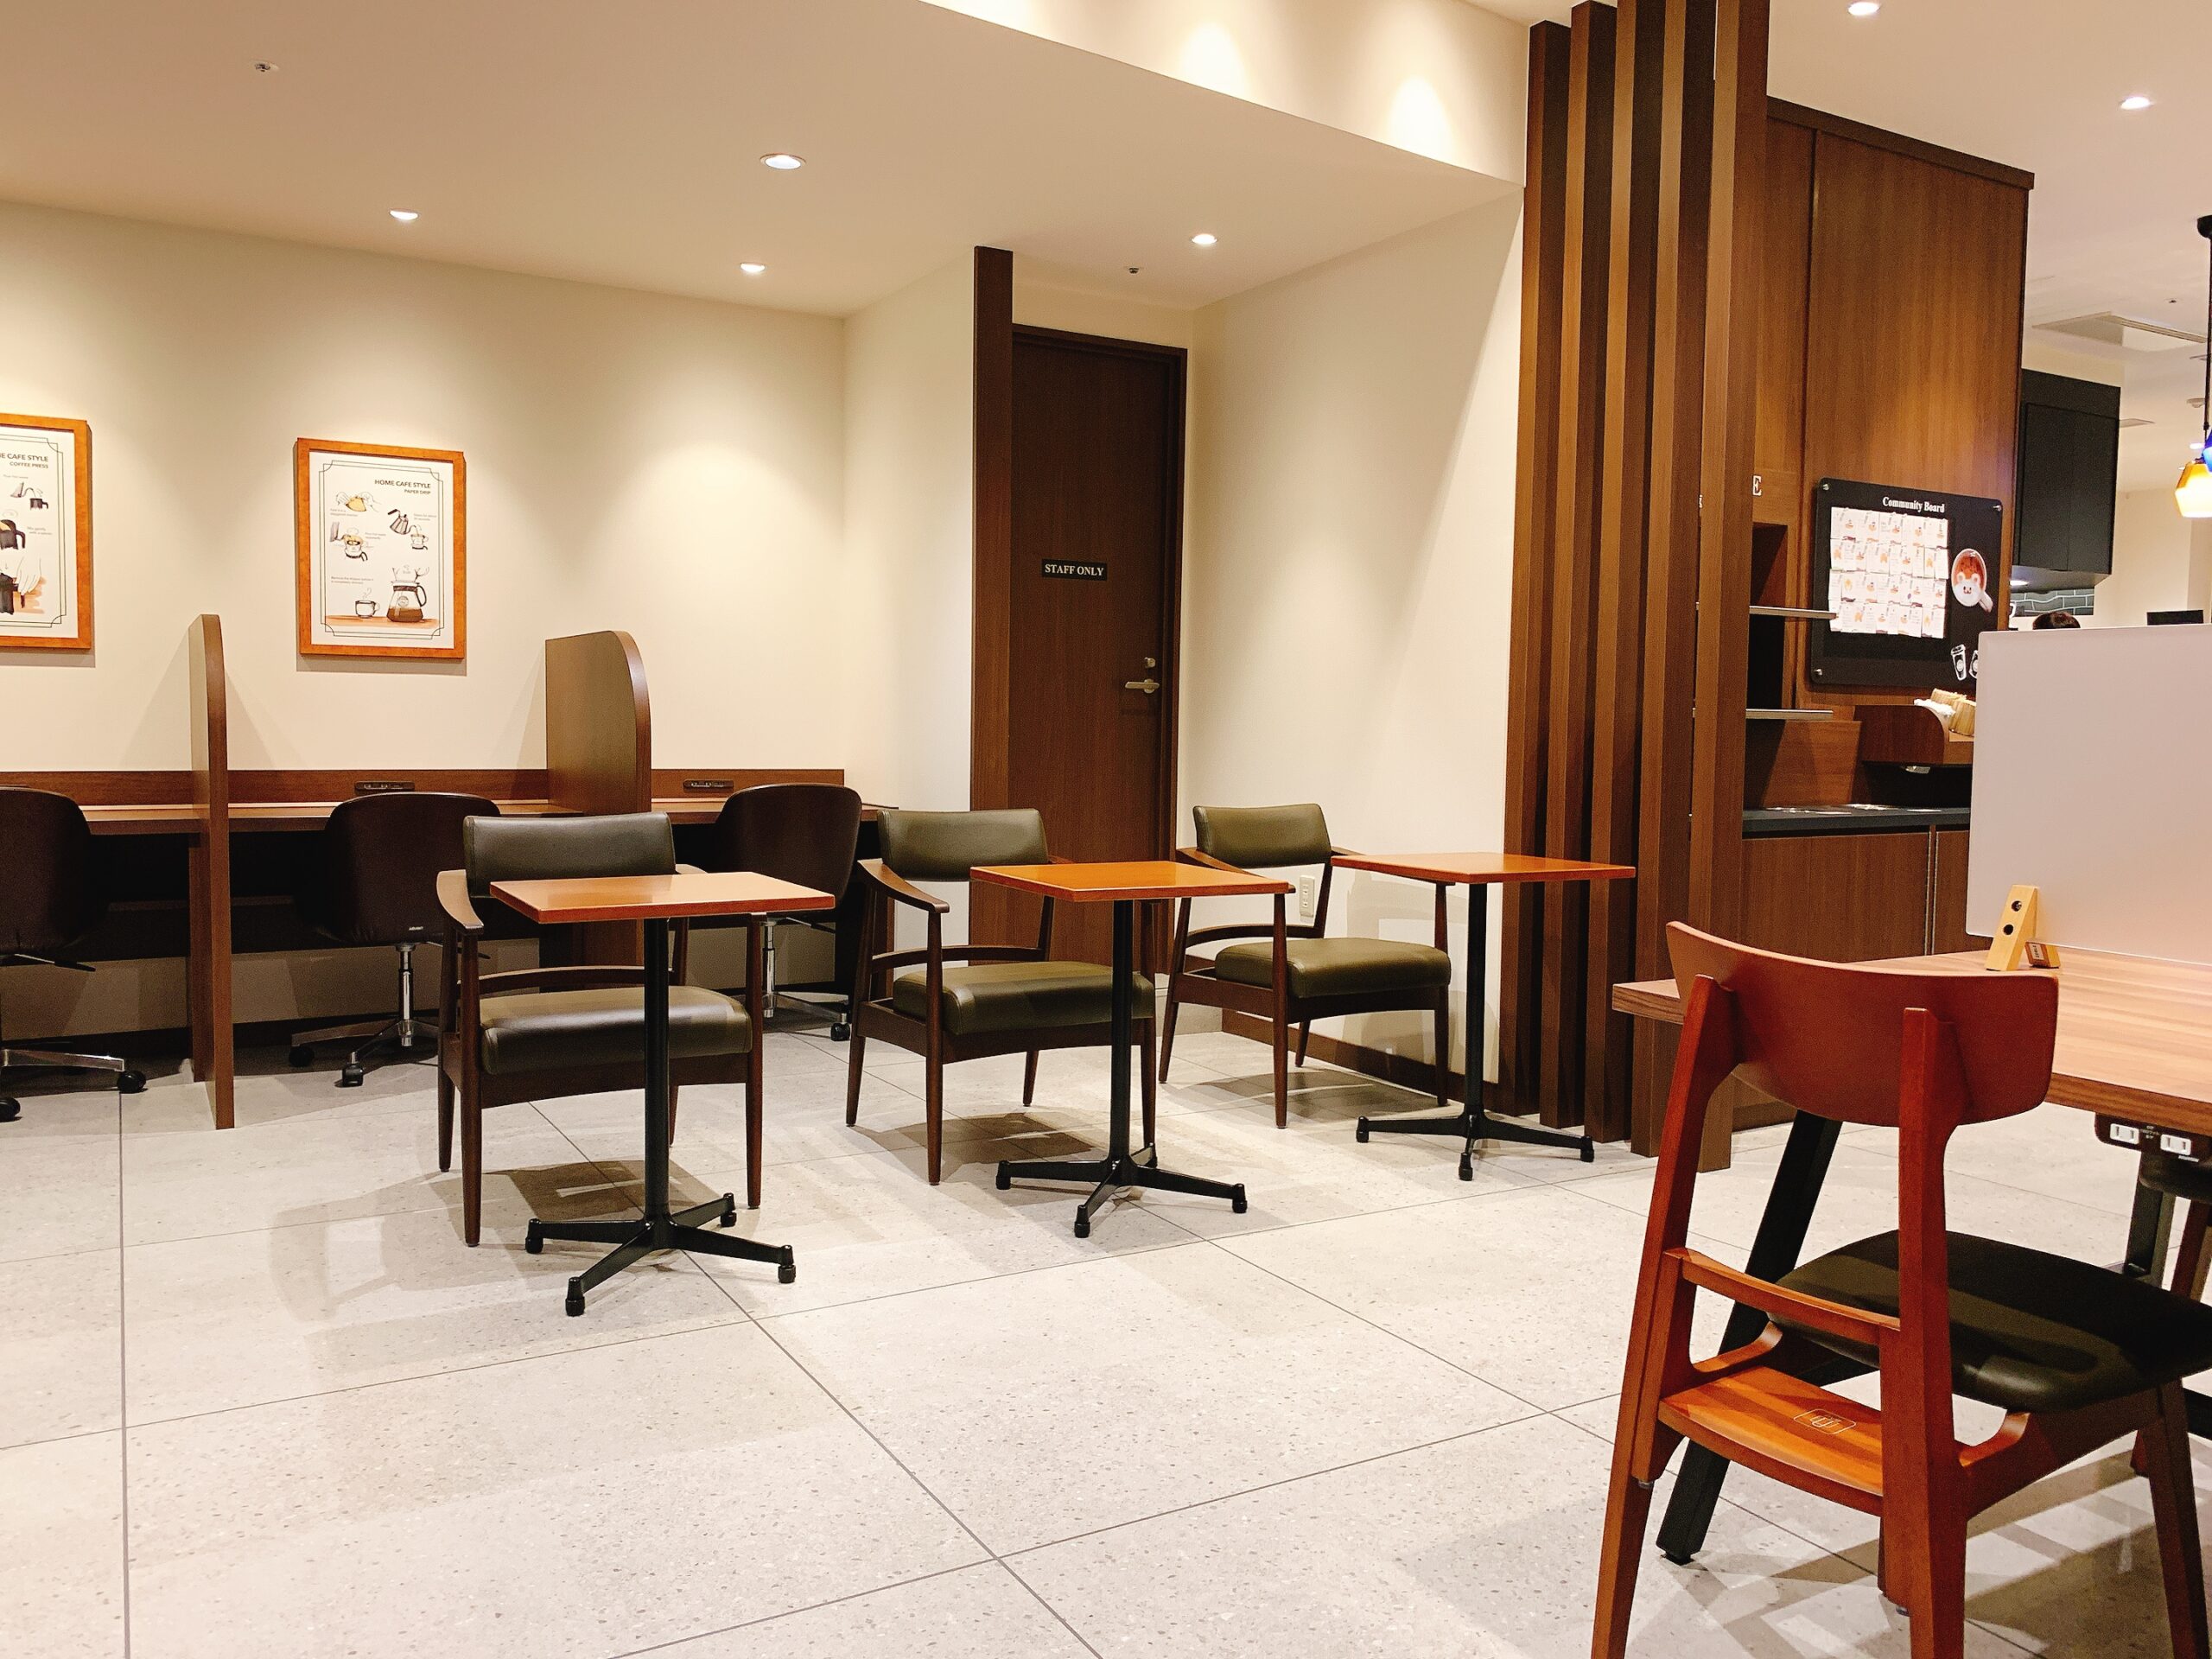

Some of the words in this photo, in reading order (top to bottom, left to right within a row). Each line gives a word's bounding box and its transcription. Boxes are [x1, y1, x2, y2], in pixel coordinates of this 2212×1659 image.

[1882, 496, 1923, 513] Community
[1924, 501, 1945, 513] Board
[1045, 563, 1076, 575] STAFF
[1077, 566, 1104, 576] ONLY
